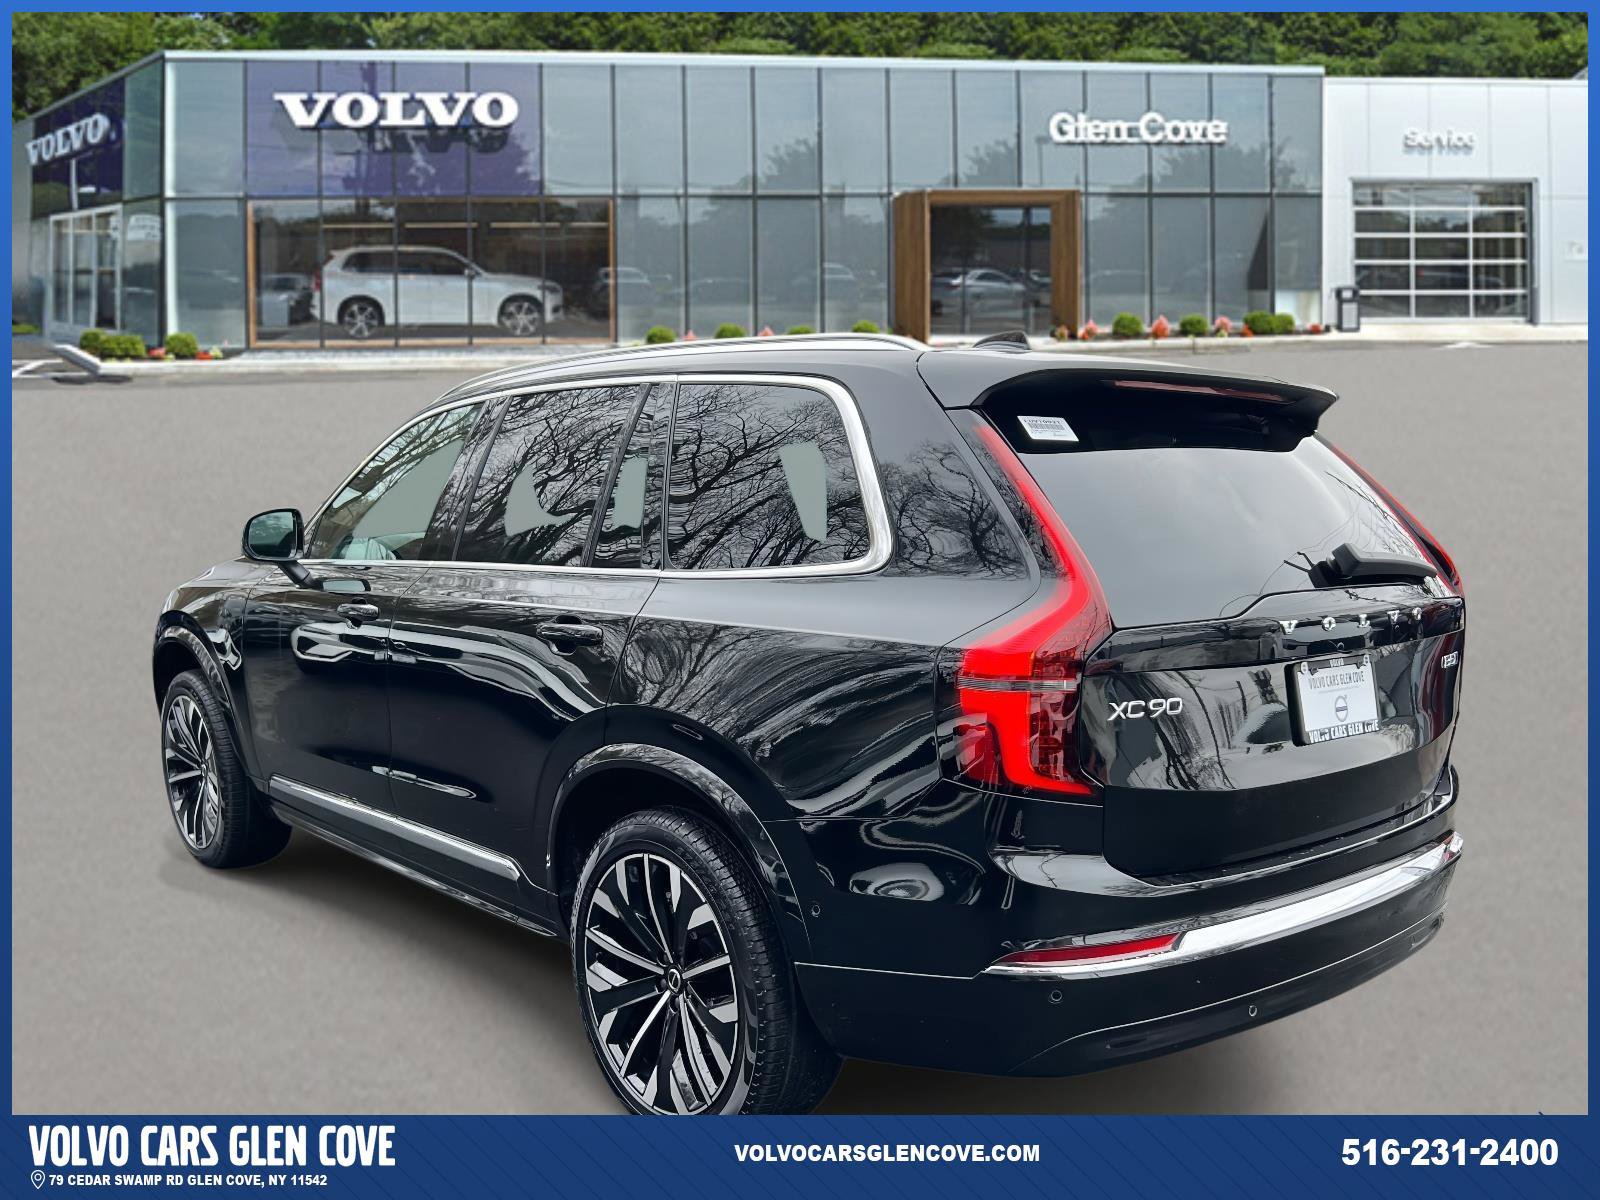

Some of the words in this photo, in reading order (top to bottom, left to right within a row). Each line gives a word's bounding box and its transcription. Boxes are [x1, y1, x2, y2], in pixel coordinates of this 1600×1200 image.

[273, 92, 519, 127] VOLVO
[25, 112, 110, 166] VOLVO
[1050, 112, 1129, 143] Glen
[1138, 112, 1229, 143] Cove
[1402, 126, 1476, 151] Service
[1278, 606, 1422, 635] VOLVO
[1308, 676, 1326, 690] VOLVO
[1326, 673, 1340, 687] CARS
[1339, 671, 1352, 685] GLEN
[1352, 670, 1365, 683] COVE
[1107, 697, 1183, 721] XC90
[1330, 725, 1348, 739] CARS
[1347, 722, 1364, 736] GLEN
